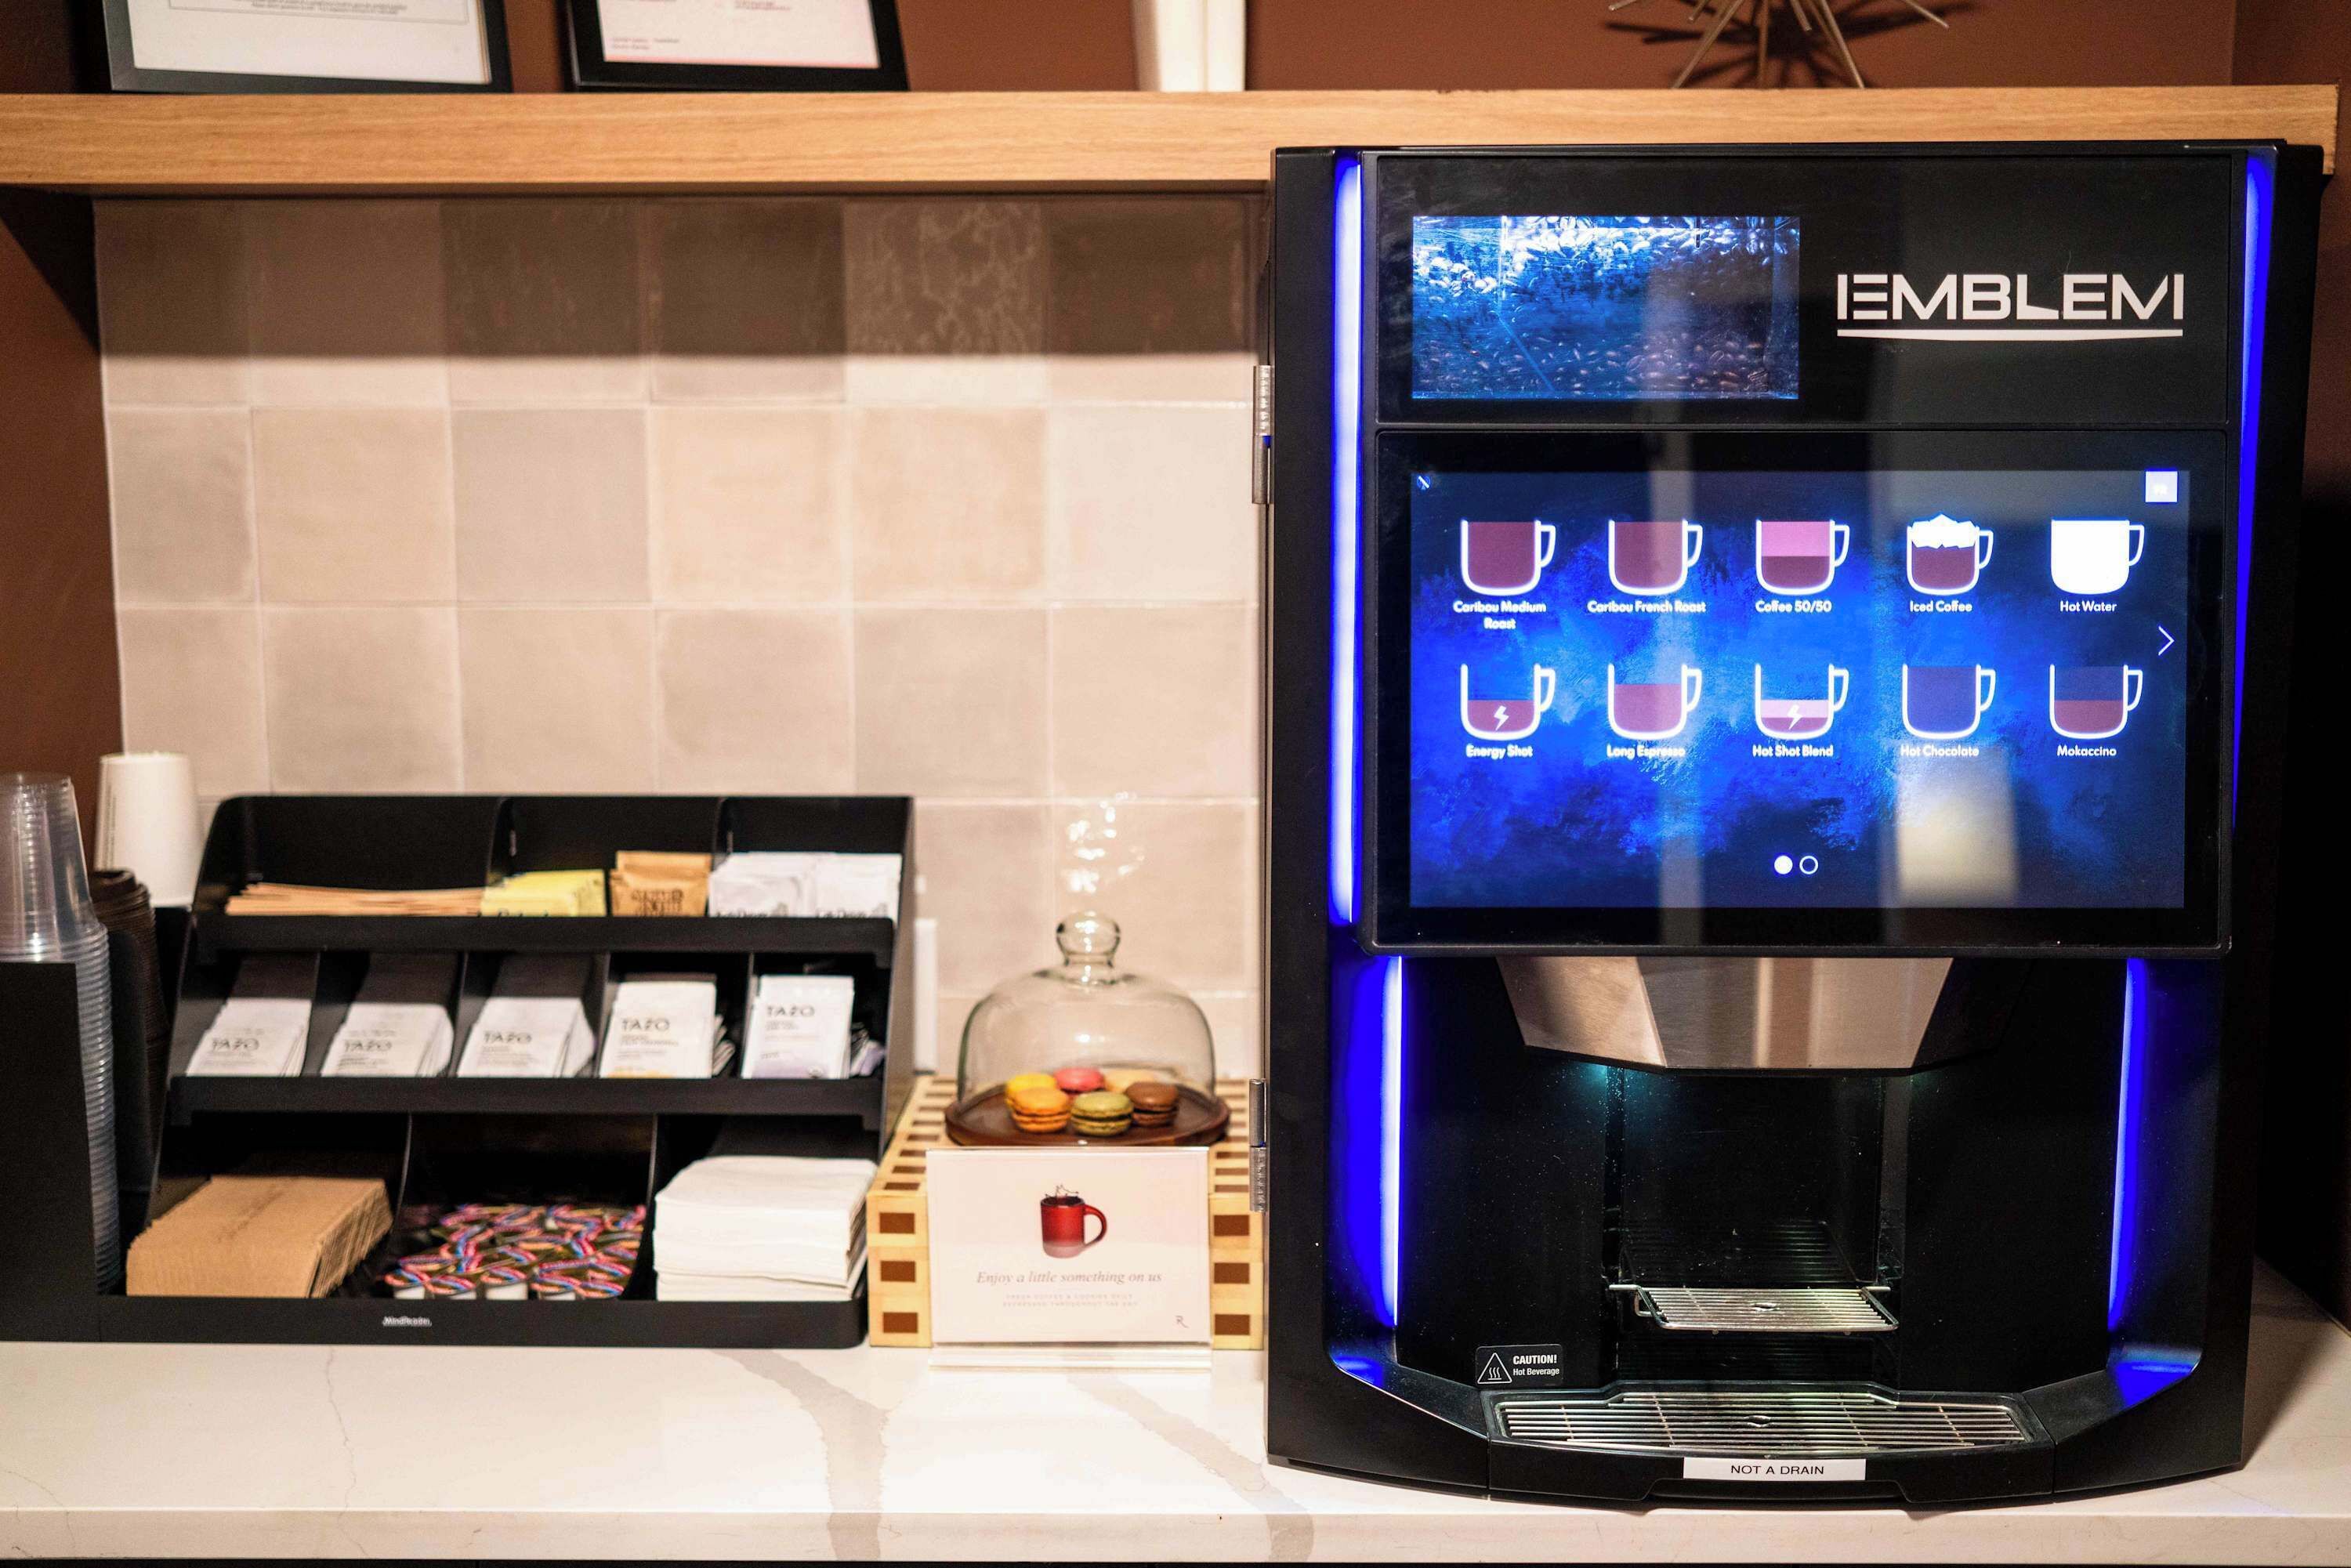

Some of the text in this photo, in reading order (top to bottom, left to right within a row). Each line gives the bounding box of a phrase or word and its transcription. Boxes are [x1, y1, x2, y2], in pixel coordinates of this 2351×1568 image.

[1453, 600, 1547, 613] Caribou Medium
[1587, 600, 1706, 613] Caribou French Roast
[1755, 599, 1832, 613] Coffee 50/50
[1910, 600, 1972, 612] Iced Coffee
[2060, 600, 2117, 612] Hot Water
[1483, 617, 1516, 629] Roast
[1465, 744, 1533, 759] Energy Shot
[1607, 744, 1686, 759] Long Espresso
[1752, 744, 1834, 757] Hot Shot Blend
[1900, 744, 1980, 757] Hot Chocolate
[2056, 744, 2117, 757] Mokaccino
[767, 1005, 815, 1017] TAZO
[622, 1018, 670, 1032] TAZO
[484, 1030, 532, 1044] TAZO
[212, 1037, 260, 1051] TAZO
[344, 1038, 393, 1052] TAZO
[976, 1271, 1163, 1285] Enjoy a little something on us
[1512, 1354, 1558, 1365] CAUTION!
[1527, 1367, 1560, 1377] Beverage
[1730, 1465, 1824, 1475] NOT A DRAIN
